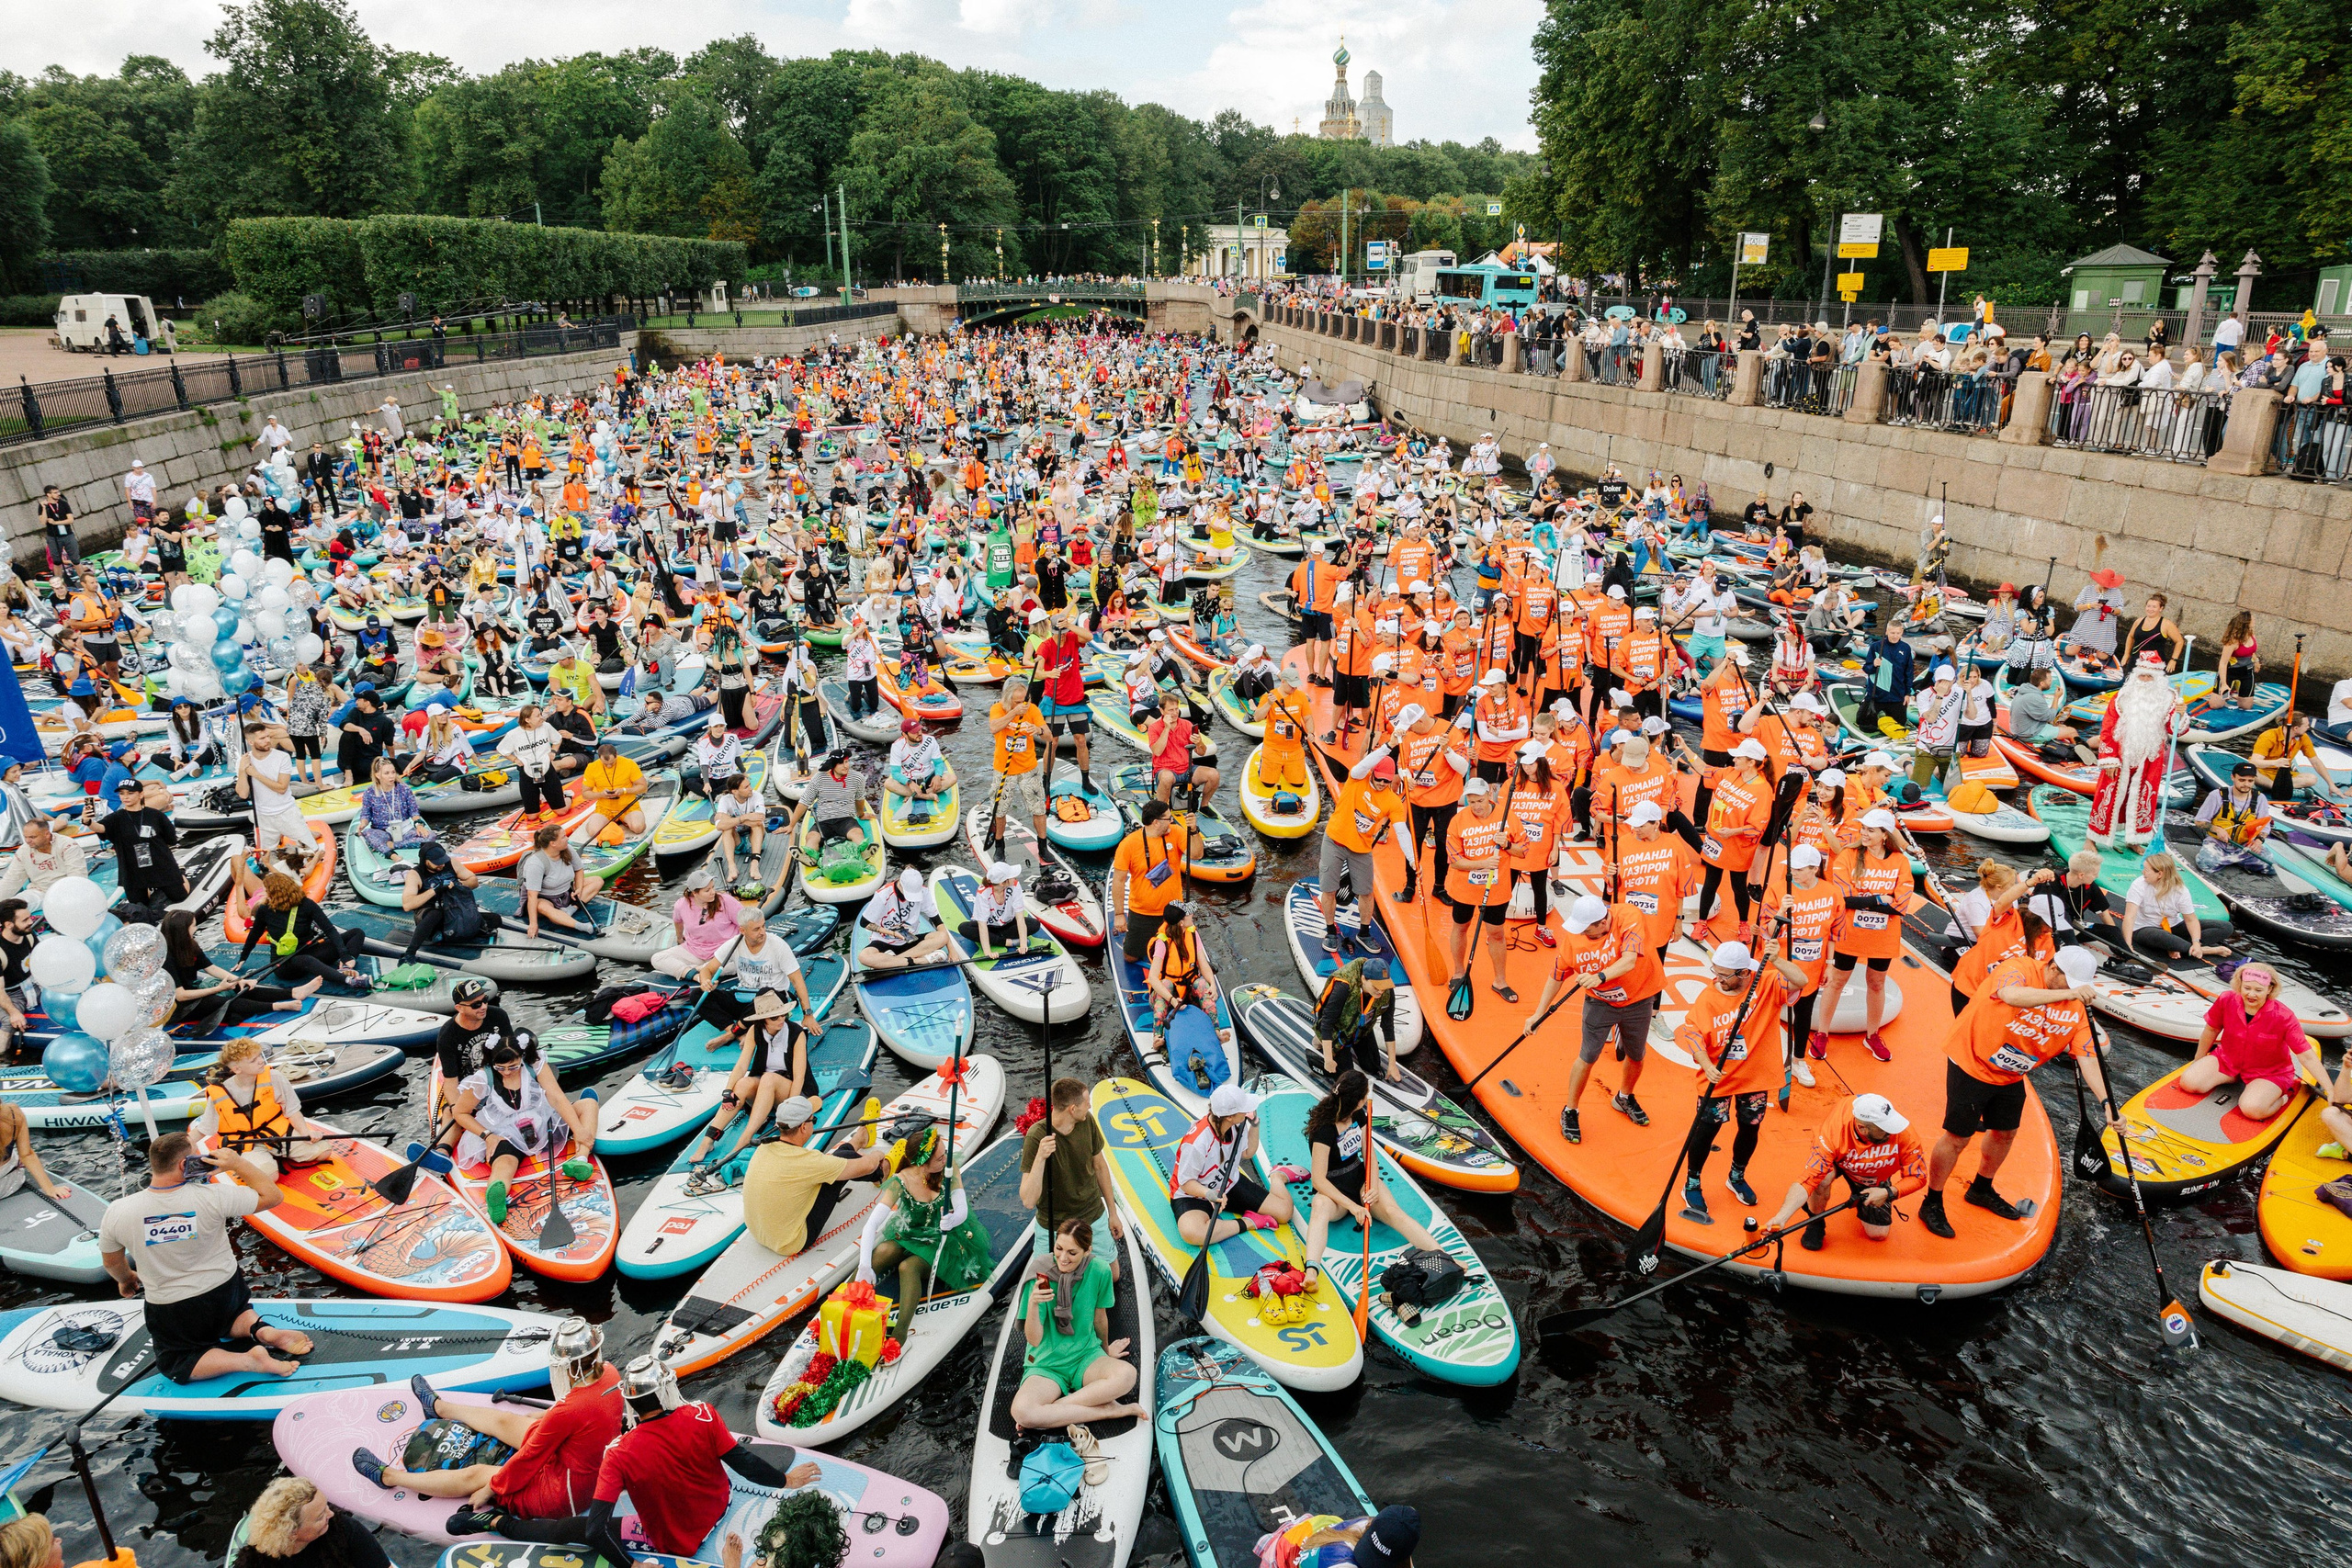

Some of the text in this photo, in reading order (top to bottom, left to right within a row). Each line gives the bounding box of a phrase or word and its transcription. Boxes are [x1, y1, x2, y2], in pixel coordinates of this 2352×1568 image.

[1623, 775, 1665, 795] КОМАНДА
[1718, 779, 1758, 805] КОМАНДА
[1510, 800, 1553, 811] ГАЗПРОМ
[1623, 788, 1663, 807] ГАЗПРОМ
[1464, 844, 1497, 858] НЕФТИ
[1623, 849, 1673, 866] КОМАНДА
[1623, 862, 1670, 879] ГАЗПРОМ
[1624, 875, 1659, 889] НЕФТИ
[1857, 915, 1885, 924] 00733
[2104, 1004, 2129, 1020] SHARK
[1996, 1053, 2030, 1071] 00749
[150, 1224, 193, 1237] 04401
[664, 1220, 693, 1233] red
[1638, 1254, 1660, 1275] Atlas
[1419, 1314, 1507, 1347] Ocean
[33, 1348, 79, 1359] KOHALA
[718, 1338, 754, 1362] Constant
[110, 1348, 150, 1380] Run
[436, 1423, 466, 1454] BAG
[457, 1432, 477, 1460] WATER
[1370, 1530, 1392, 1556] STENOVA
